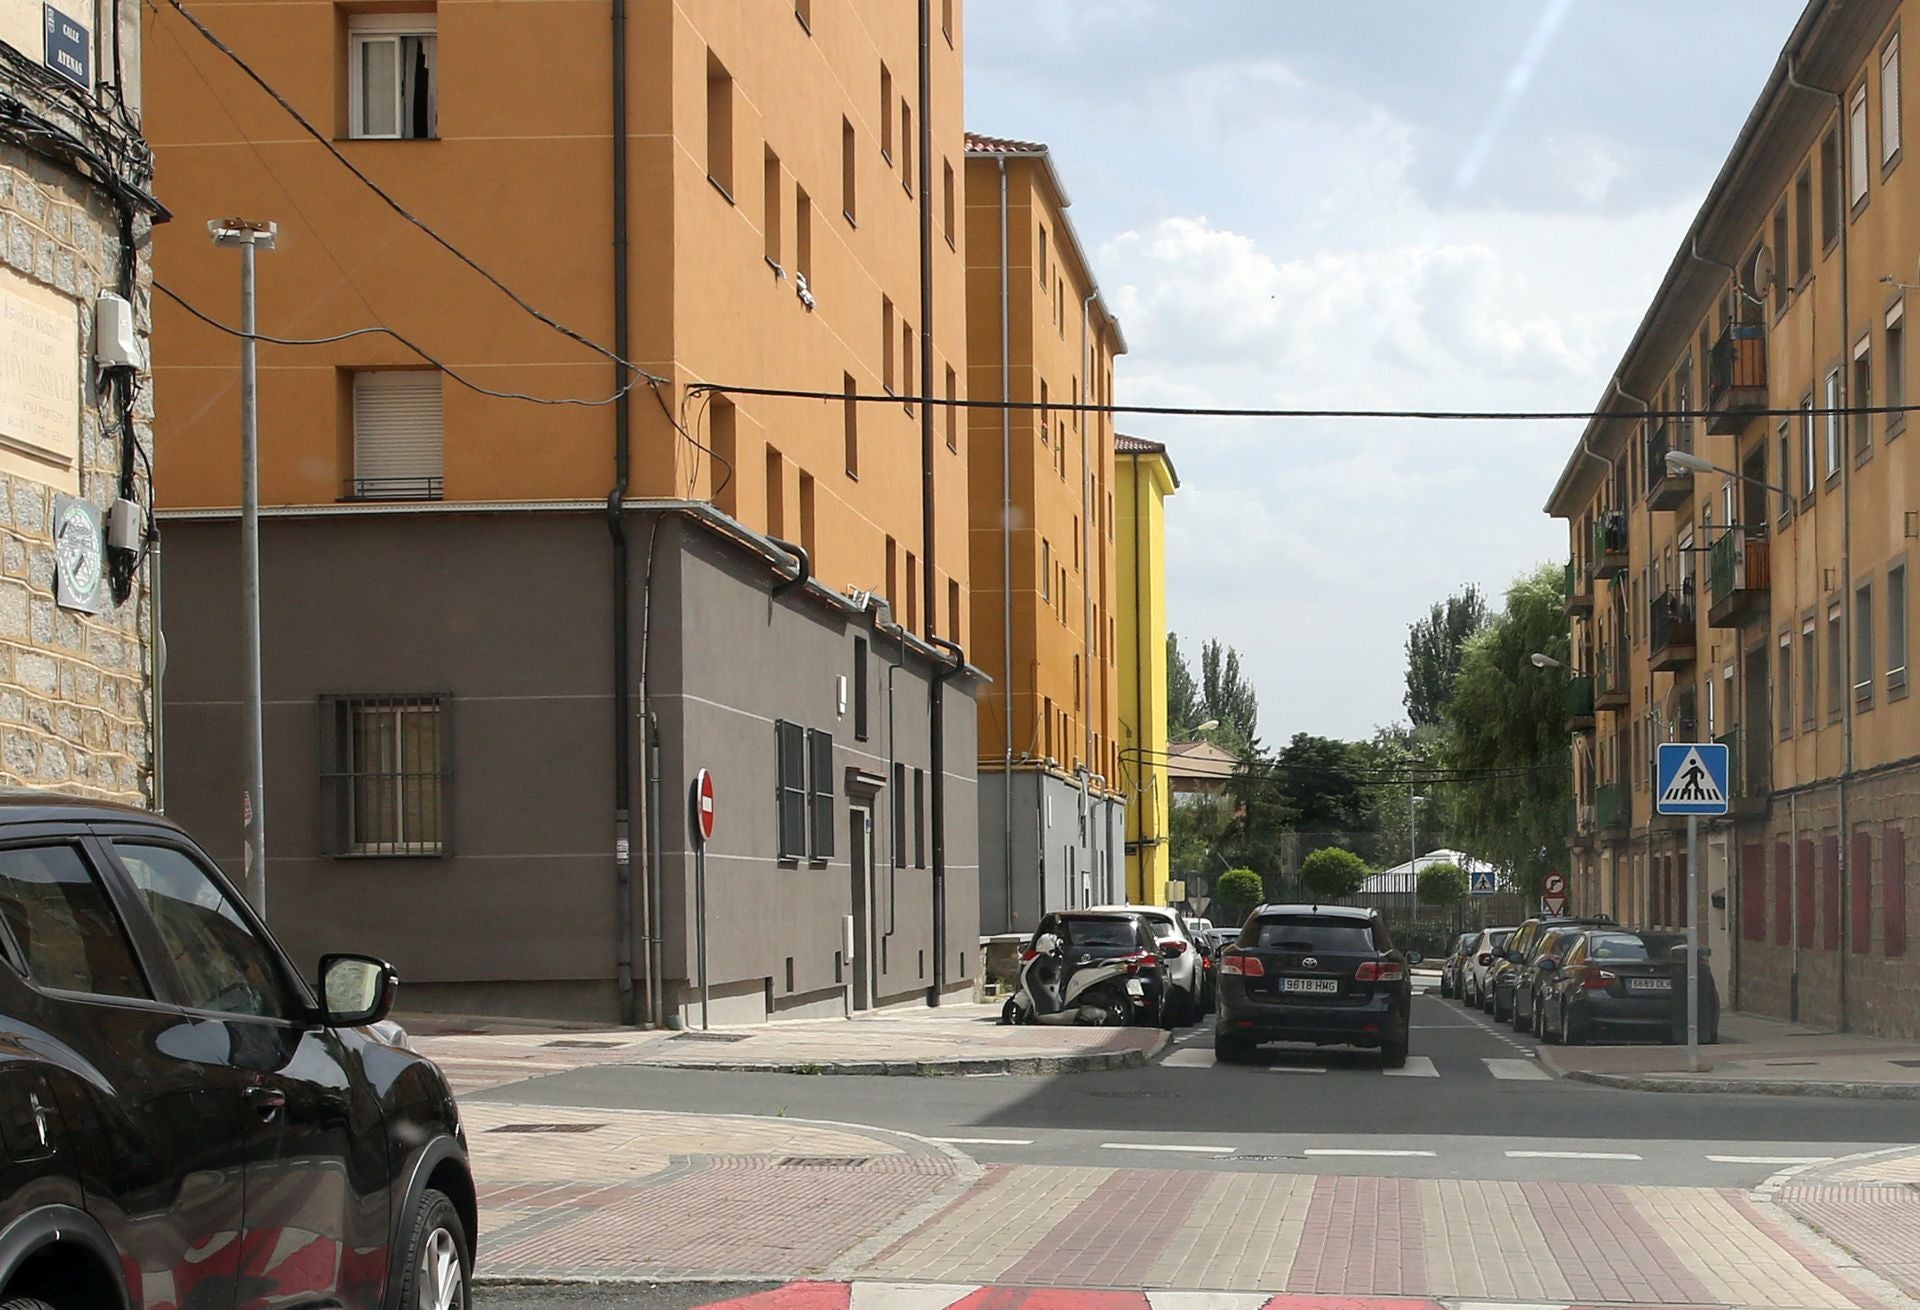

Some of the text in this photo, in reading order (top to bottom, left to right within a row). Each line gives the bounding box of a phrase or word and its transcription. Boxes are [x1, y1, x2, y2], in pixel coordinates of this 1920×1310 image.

[63, 24, 79, 43] CALLE
[57, 49, 83, 76] ATENAS
[1286, 979, 1336, 991] 9618 HMG
